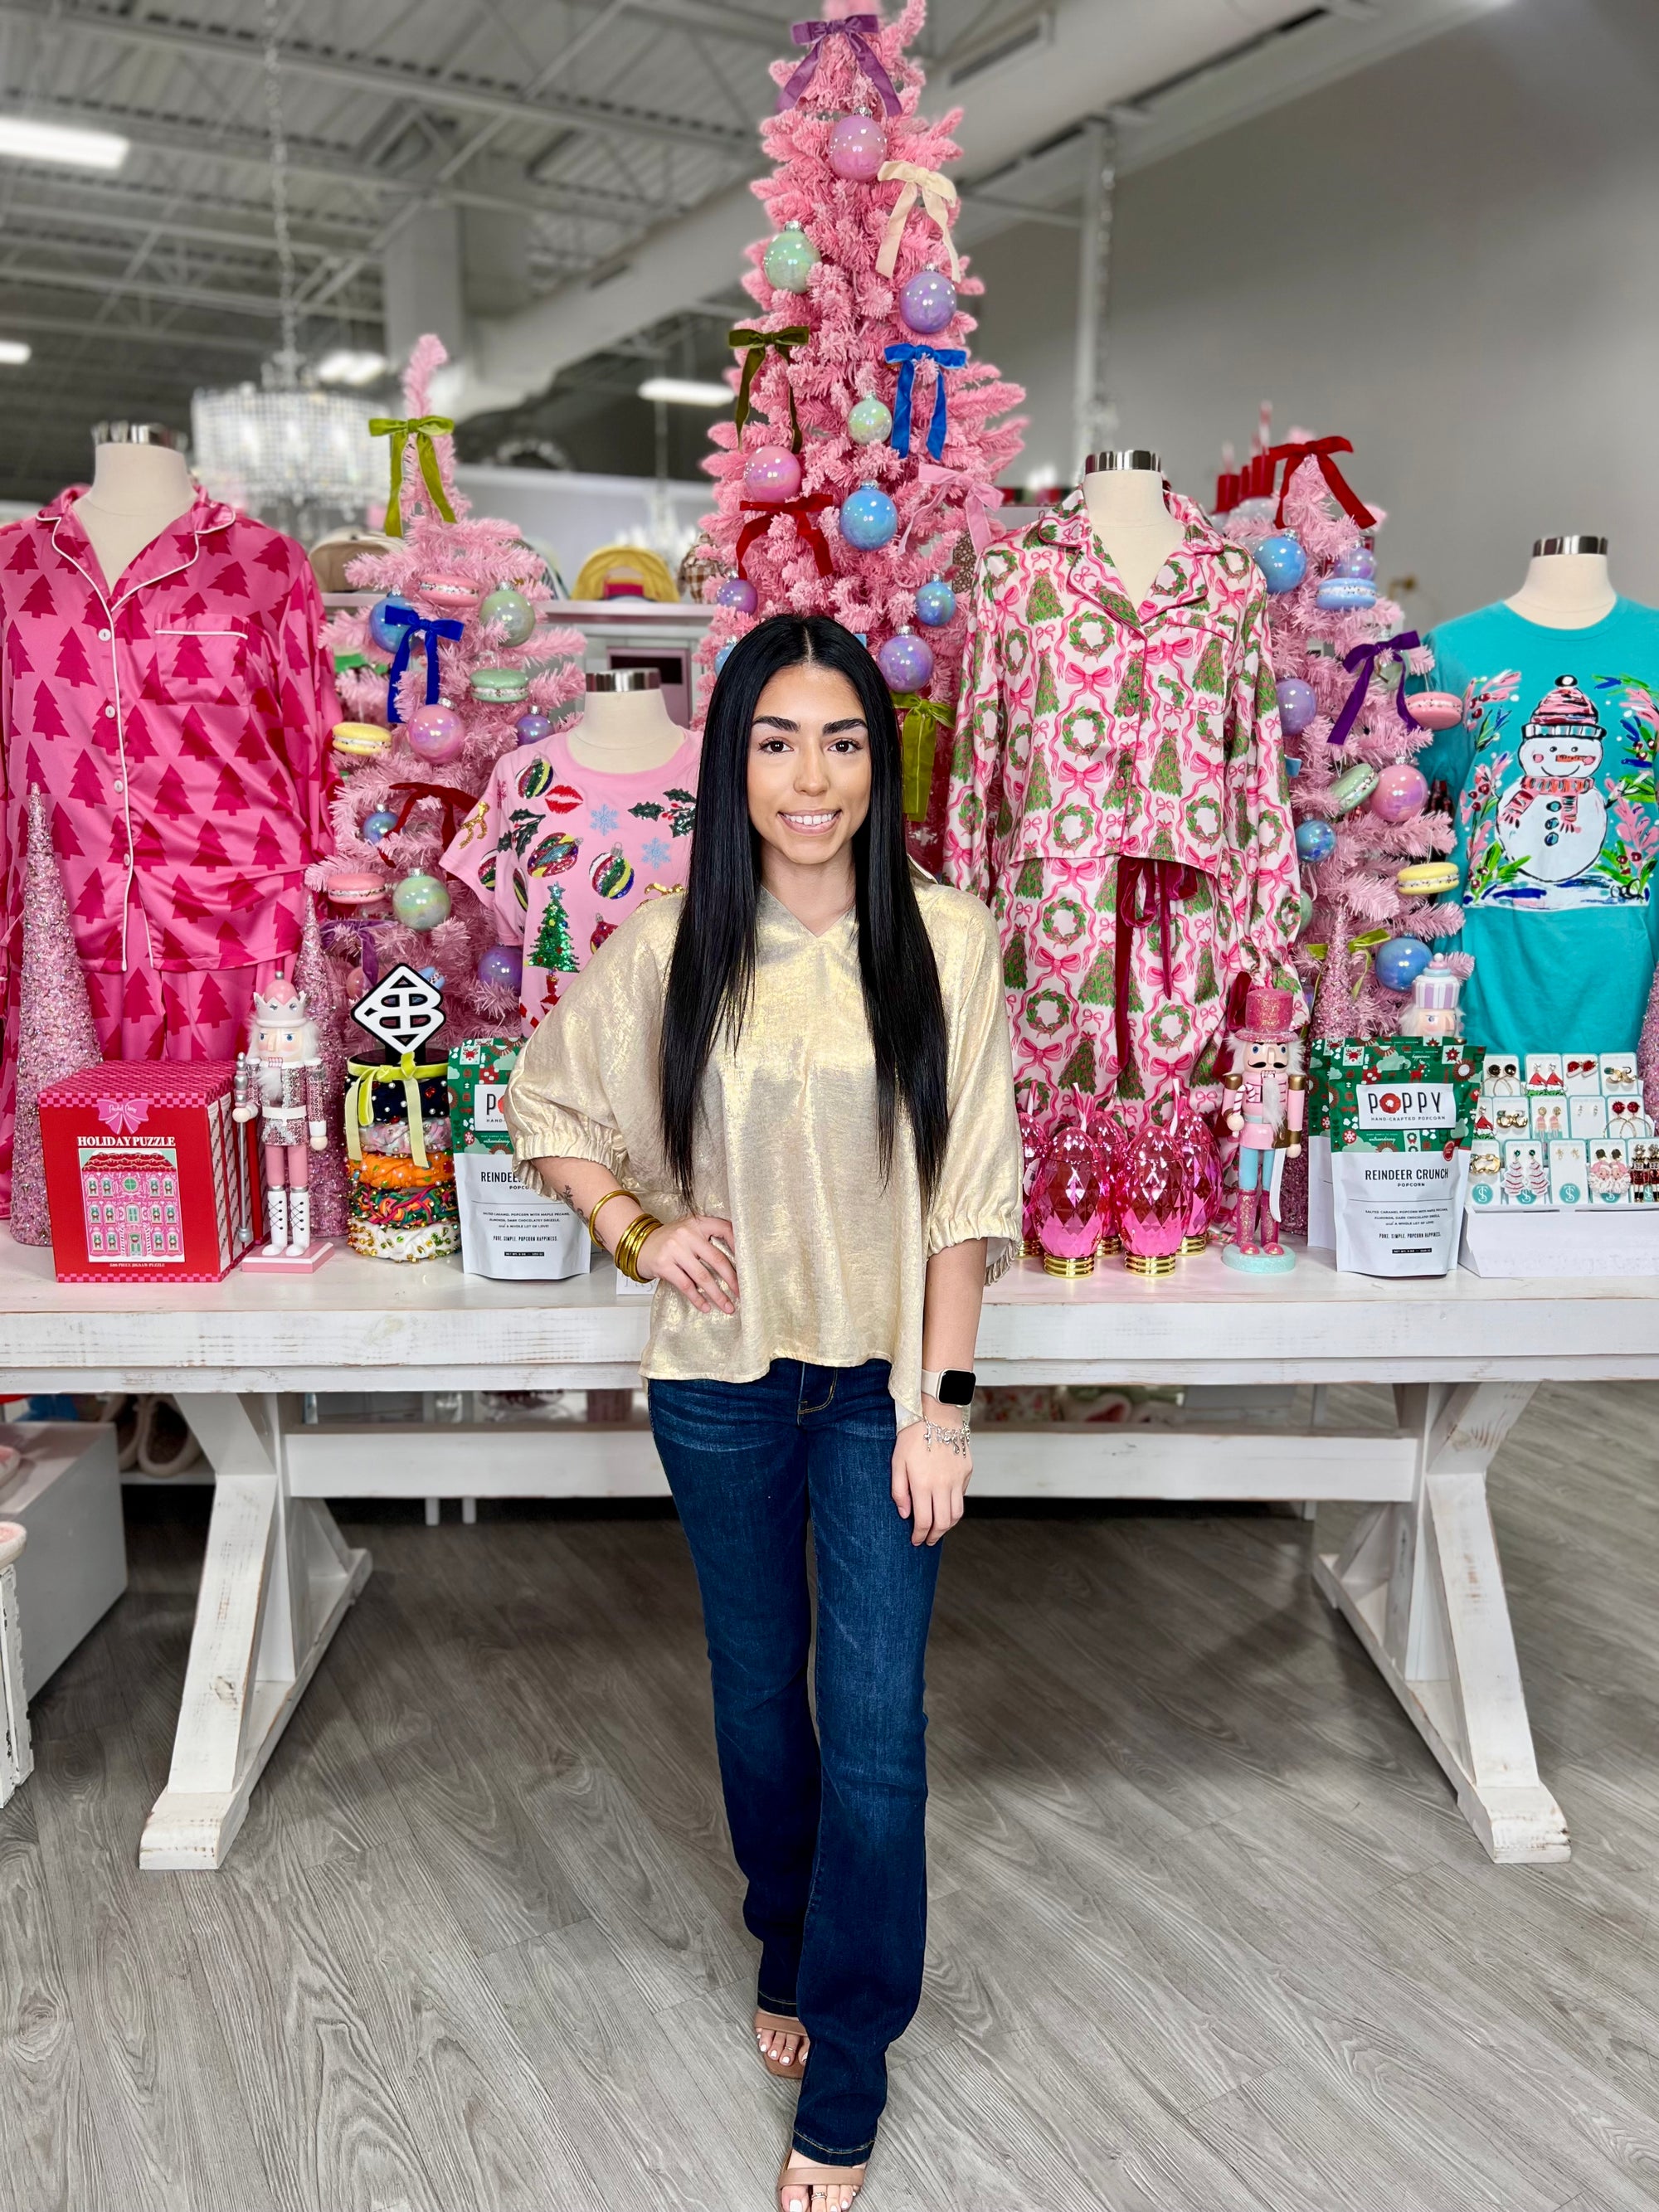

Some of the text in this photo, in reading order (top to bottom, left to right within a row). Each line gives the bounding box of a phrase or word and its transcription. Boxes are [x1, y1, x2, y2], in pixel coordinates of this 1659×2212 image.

[1368, 1091, 1442, 1115] POPPY
[77, 1136, 176, 1146] HOLIDAY PUZZLE
[481, 1171, 521, 1183] REINDEE
[1365, 1168, 1449, 1180] REINDEER CRUNCH
